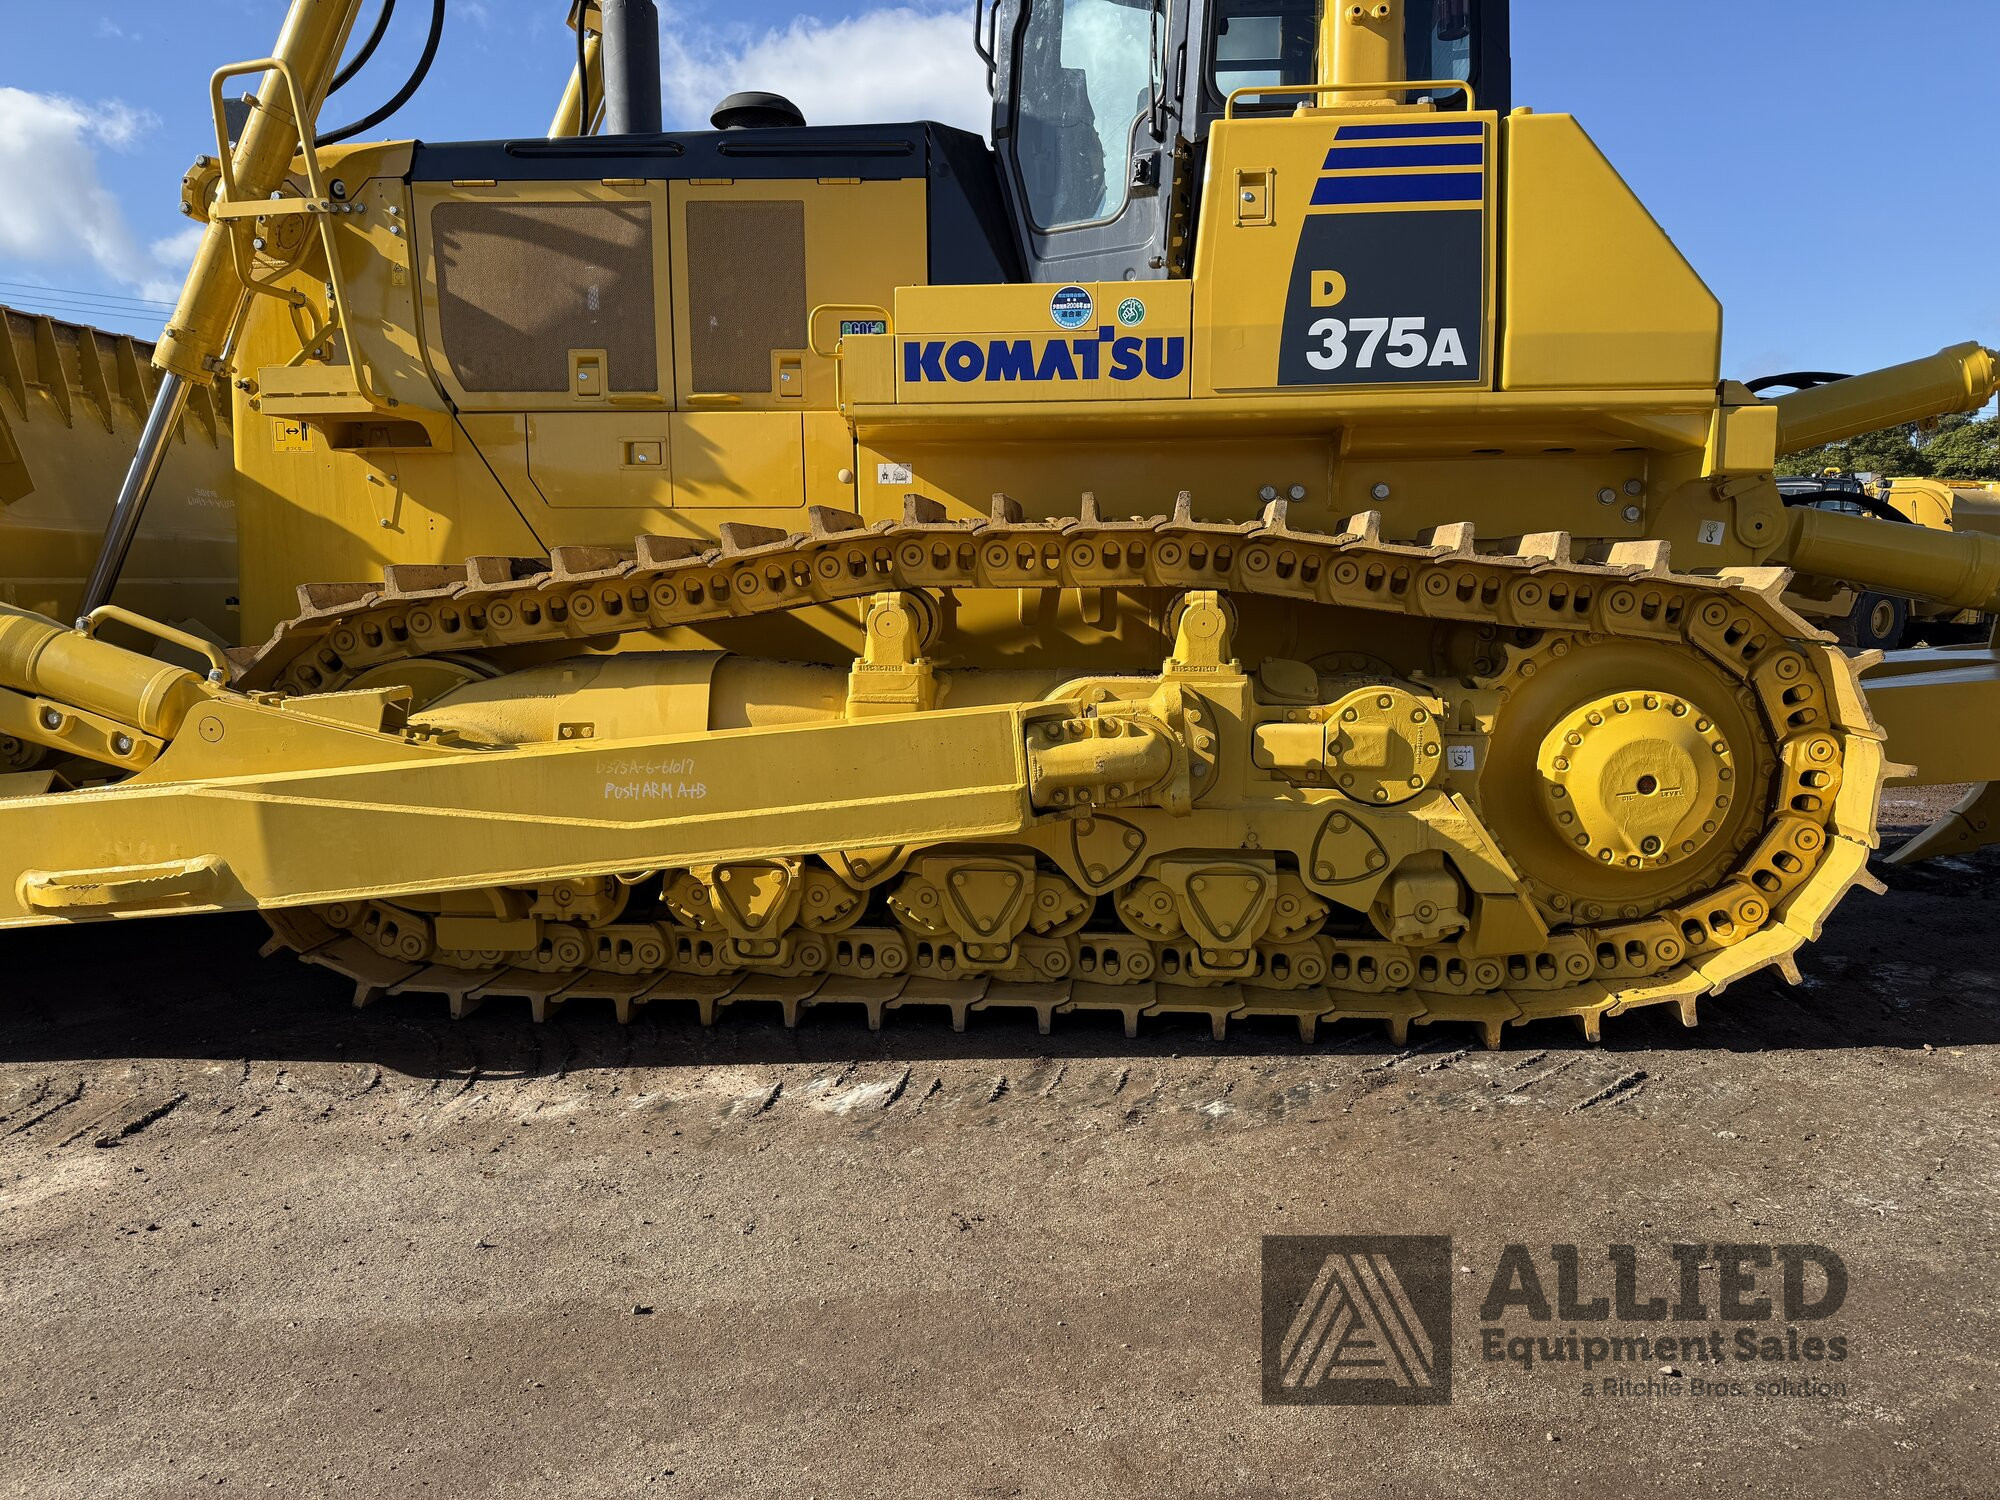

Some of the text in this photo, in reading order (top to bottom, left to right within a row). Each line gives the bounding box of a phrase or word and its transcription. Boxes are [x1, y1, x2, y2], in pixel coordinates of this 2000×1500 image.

[1311, 270, 1346, 307] D
[903, 326, 1185, 382] KOMATSU
[1306, 316, 1468, 371] 375A
[641, 781, 673, 799] ARM
